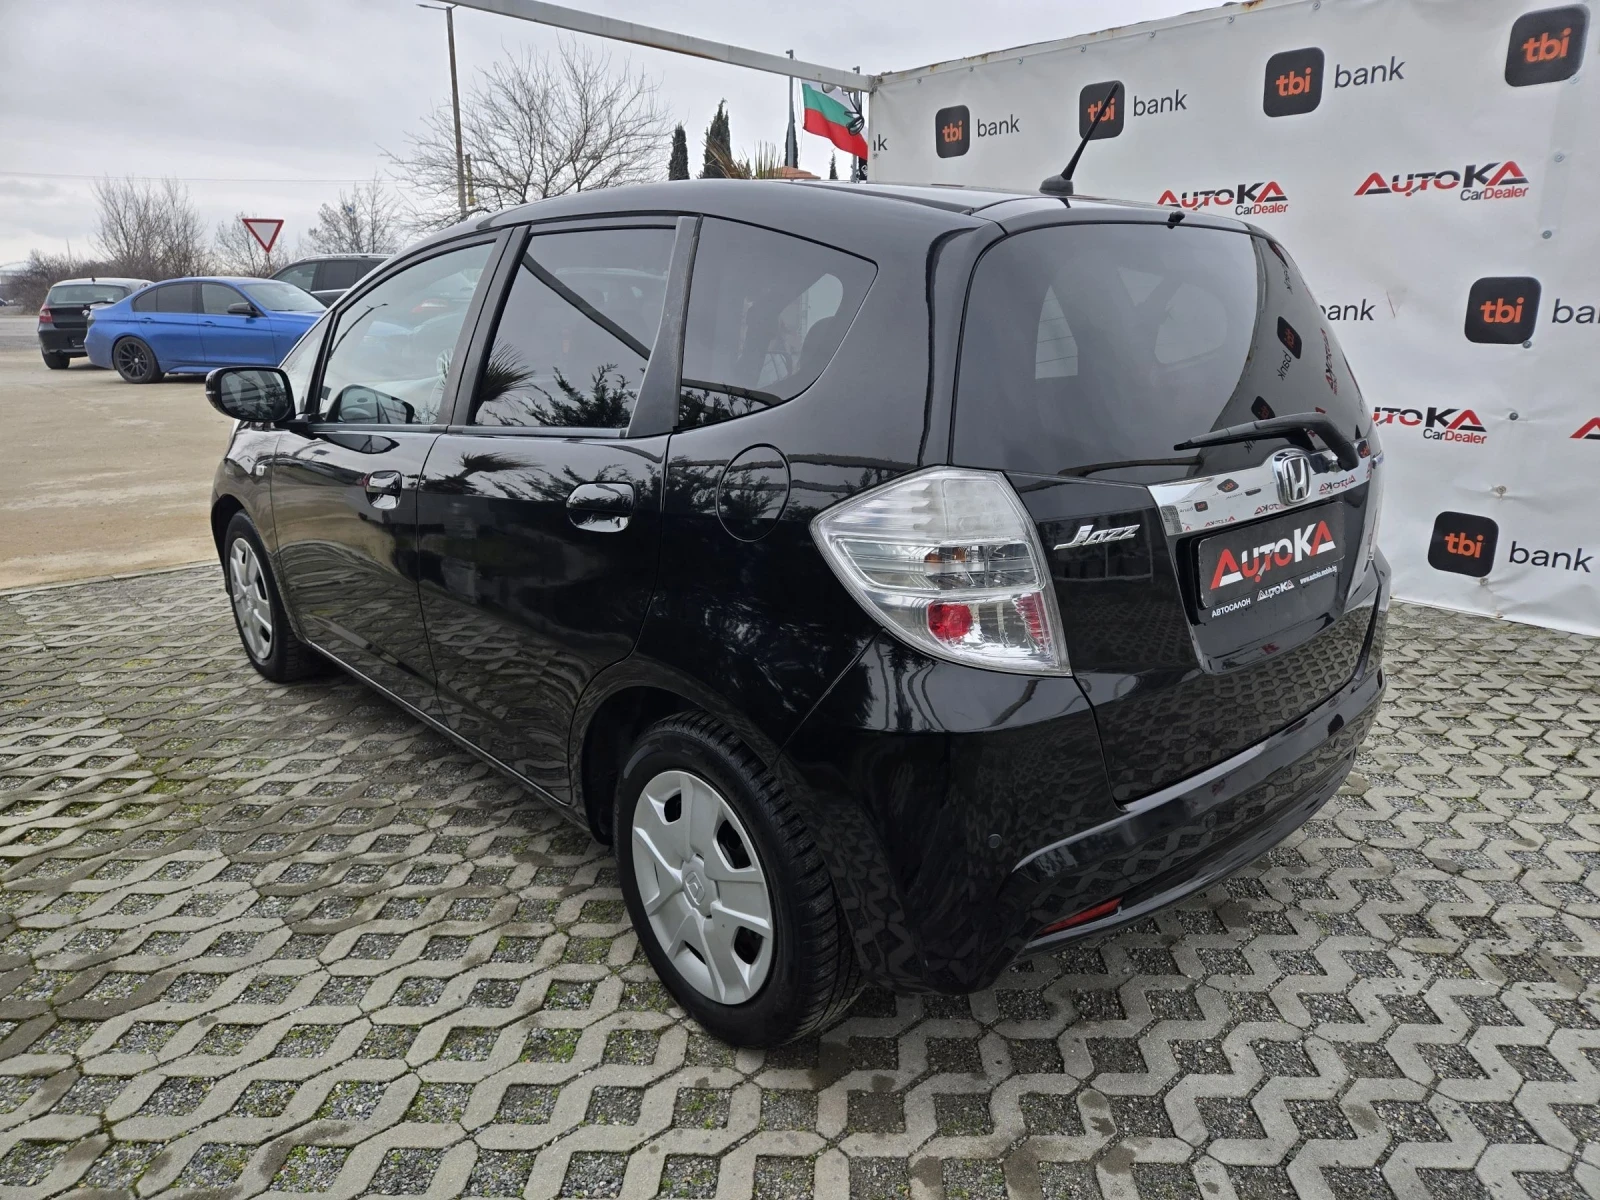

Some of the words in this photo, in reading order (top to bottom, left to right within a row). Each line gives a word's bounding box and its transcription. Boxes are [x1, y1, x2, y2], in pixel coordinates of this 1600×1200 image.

[1522, 27, 1572, 63] tbi
[1275, 67, 1312, 97] tbi
[1334, 56, 1406, 89] bank
[1133, 89, 1188, 117] bank
[942, 120, 963, 143] tbi
[977, 114, 1020, 138] bank
[1460, 185, 1530, 201] CarDealer
[1235, 202, 1289, 216] CarDealer
[1480, 297, 1525, 324] tbi
[1551, 298, 1600, 324] ba
[1422, 428, 1488, 444] CarDealer
[1053, 524, 1141, 551] Jazz
[1210, 520, 1336, 590] AUTOKA
[1444, 532, 1485, 559] tbi
[1508, 541, 1594, 573] bank
